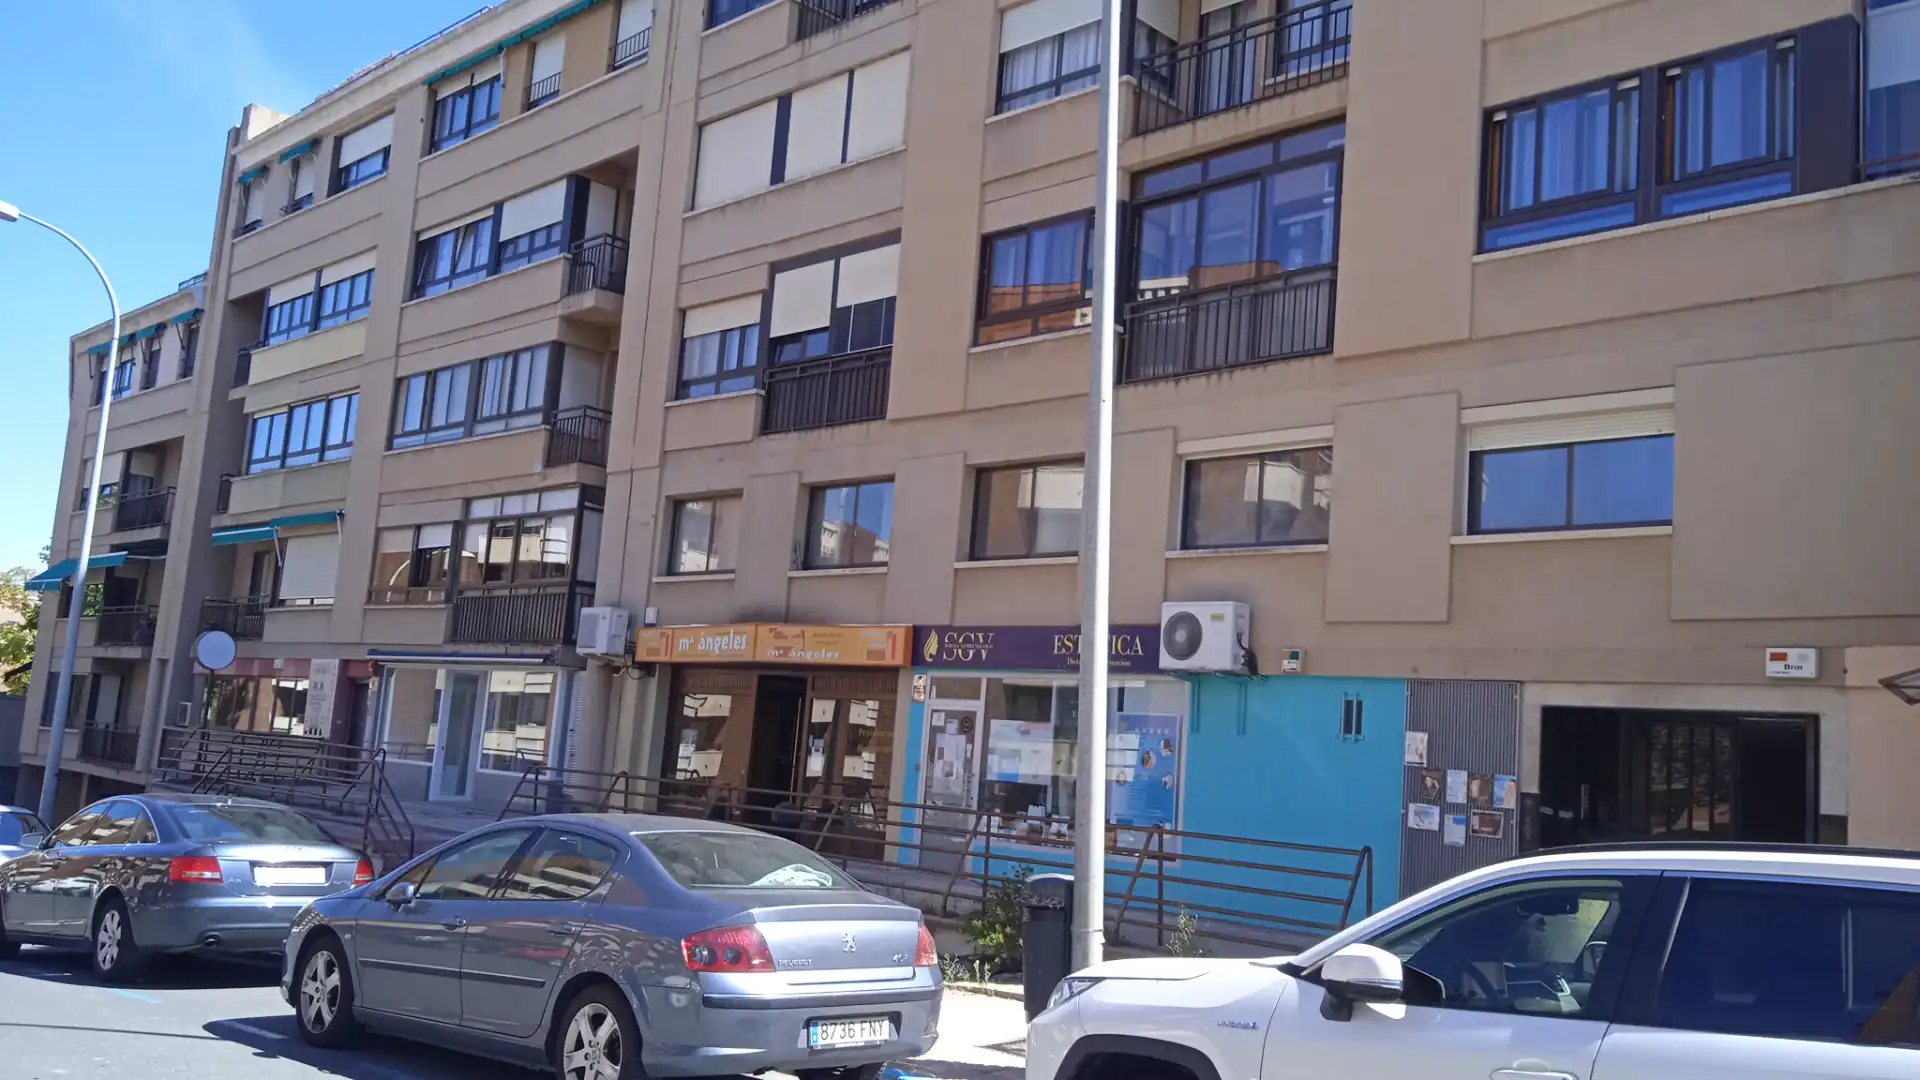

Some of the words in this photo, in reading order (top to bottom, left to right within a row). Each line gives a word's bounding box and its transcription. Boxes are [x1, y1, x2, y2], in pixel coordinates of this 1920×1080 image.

[943, 632, 994, 661] SGV
[1053, 634, 1144, 656] ESTICA
[778, 959, 813, 967] PEUGEOT
[821, 1021, 856, 1041] 8736
[860, 1019, 885, 1038] FNY
